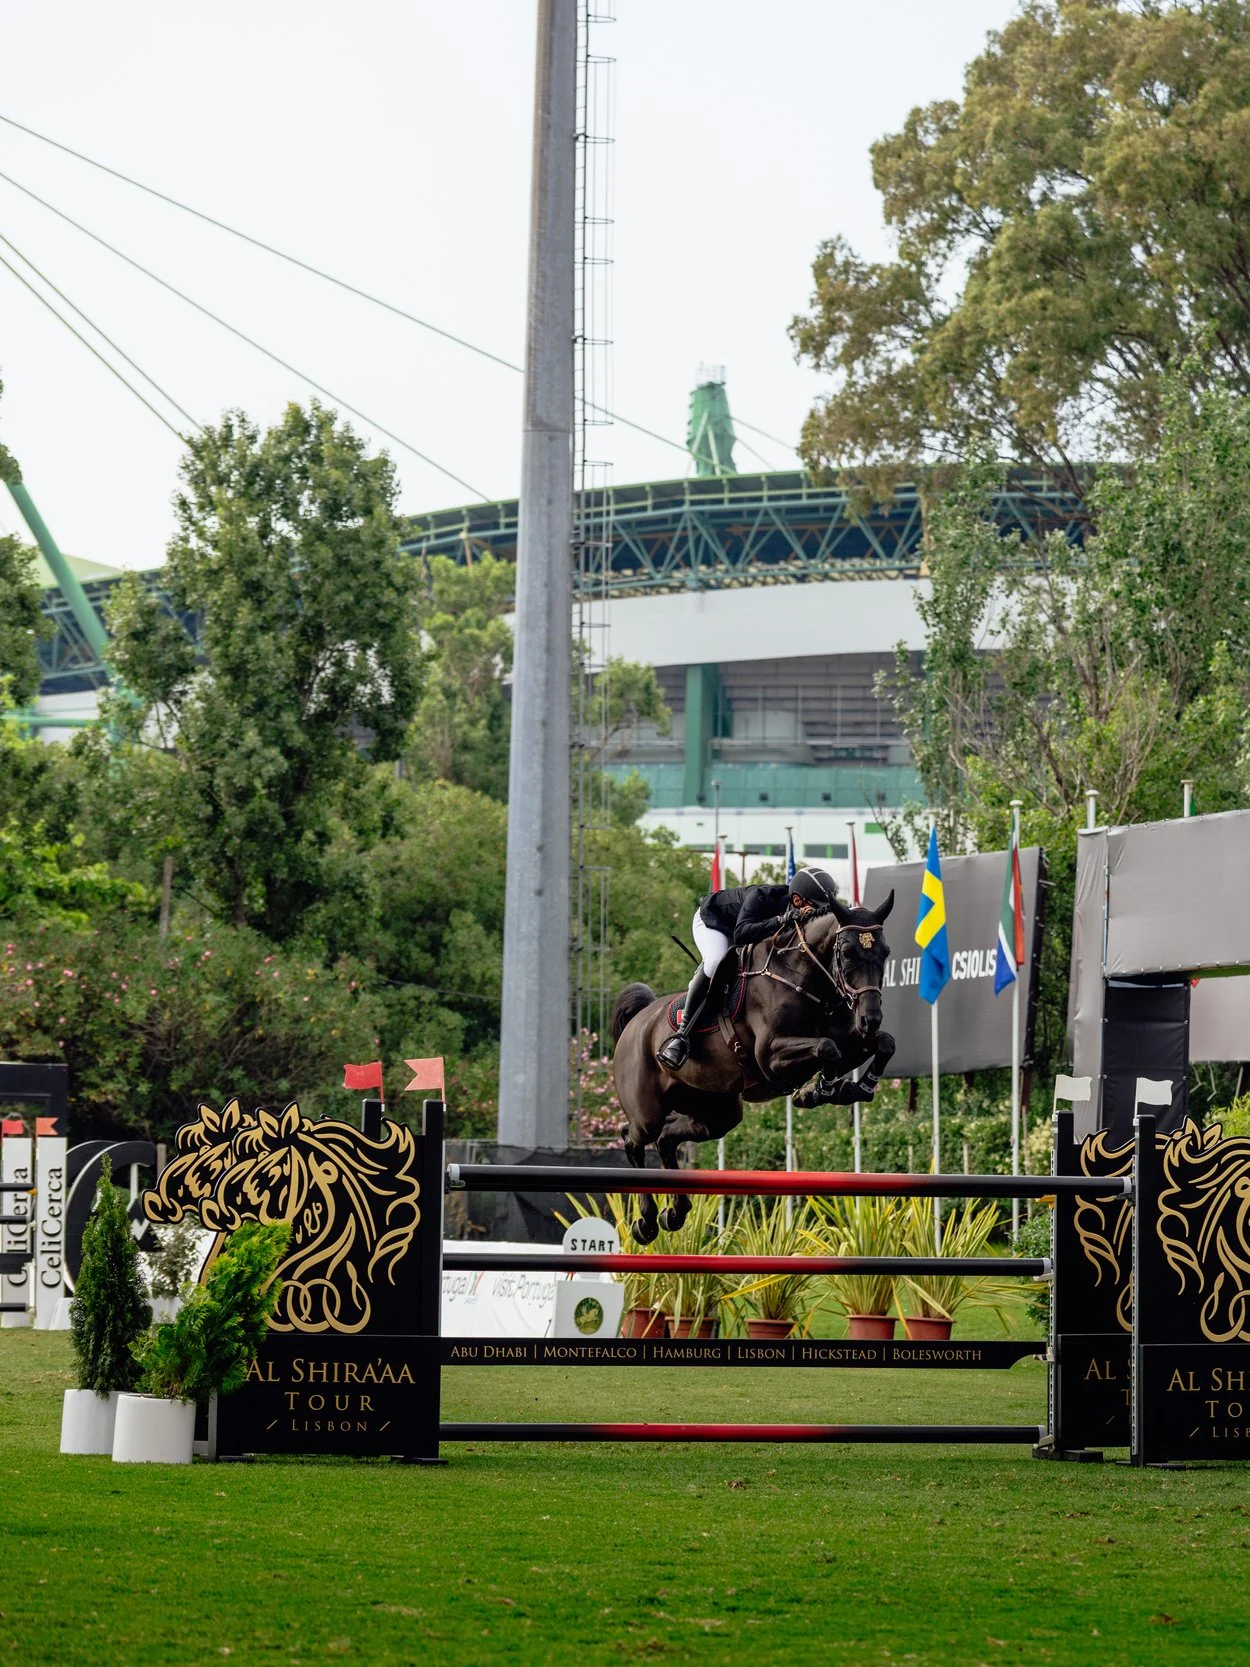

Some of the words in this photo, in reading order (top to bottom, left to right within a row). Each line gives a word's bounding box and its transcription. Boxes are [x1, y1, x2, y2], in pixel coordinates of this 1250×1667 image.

[882, 959, 897, 988] AL
[951, 948, 997, 981] CSIOLIS
[8, 1167, 28, 1287] CliCera
[40, 1167, 63, 1289] CeliCerca
[570, 1238, 615, 1252] START
[491, 1271, 515, 1298] visit
[516, 1273, 557, 1309] Portuga
[450, 1345, 479, 1359] ABU
[483, 1345, 528, 1359] DHABI
[543, 1346, 638, 1359] MONTEFALCO
[652, 1346, 722, 1360] HAMBURG
[737, 1346, 786, 1360] LISBON
[801, 1347, 877, 1361] HICKSTEAD
[892, 1347, 983, 1362] BOLESWORTH
[245, 1358, 280, 1382] AL
[1083, 1357, 1117, 1381] AL
[1166, 1368, 1201, 1392] AL
[284, 1391, 375, 1412] TOUR
[291, 1418, 368, 1432] LISBON
